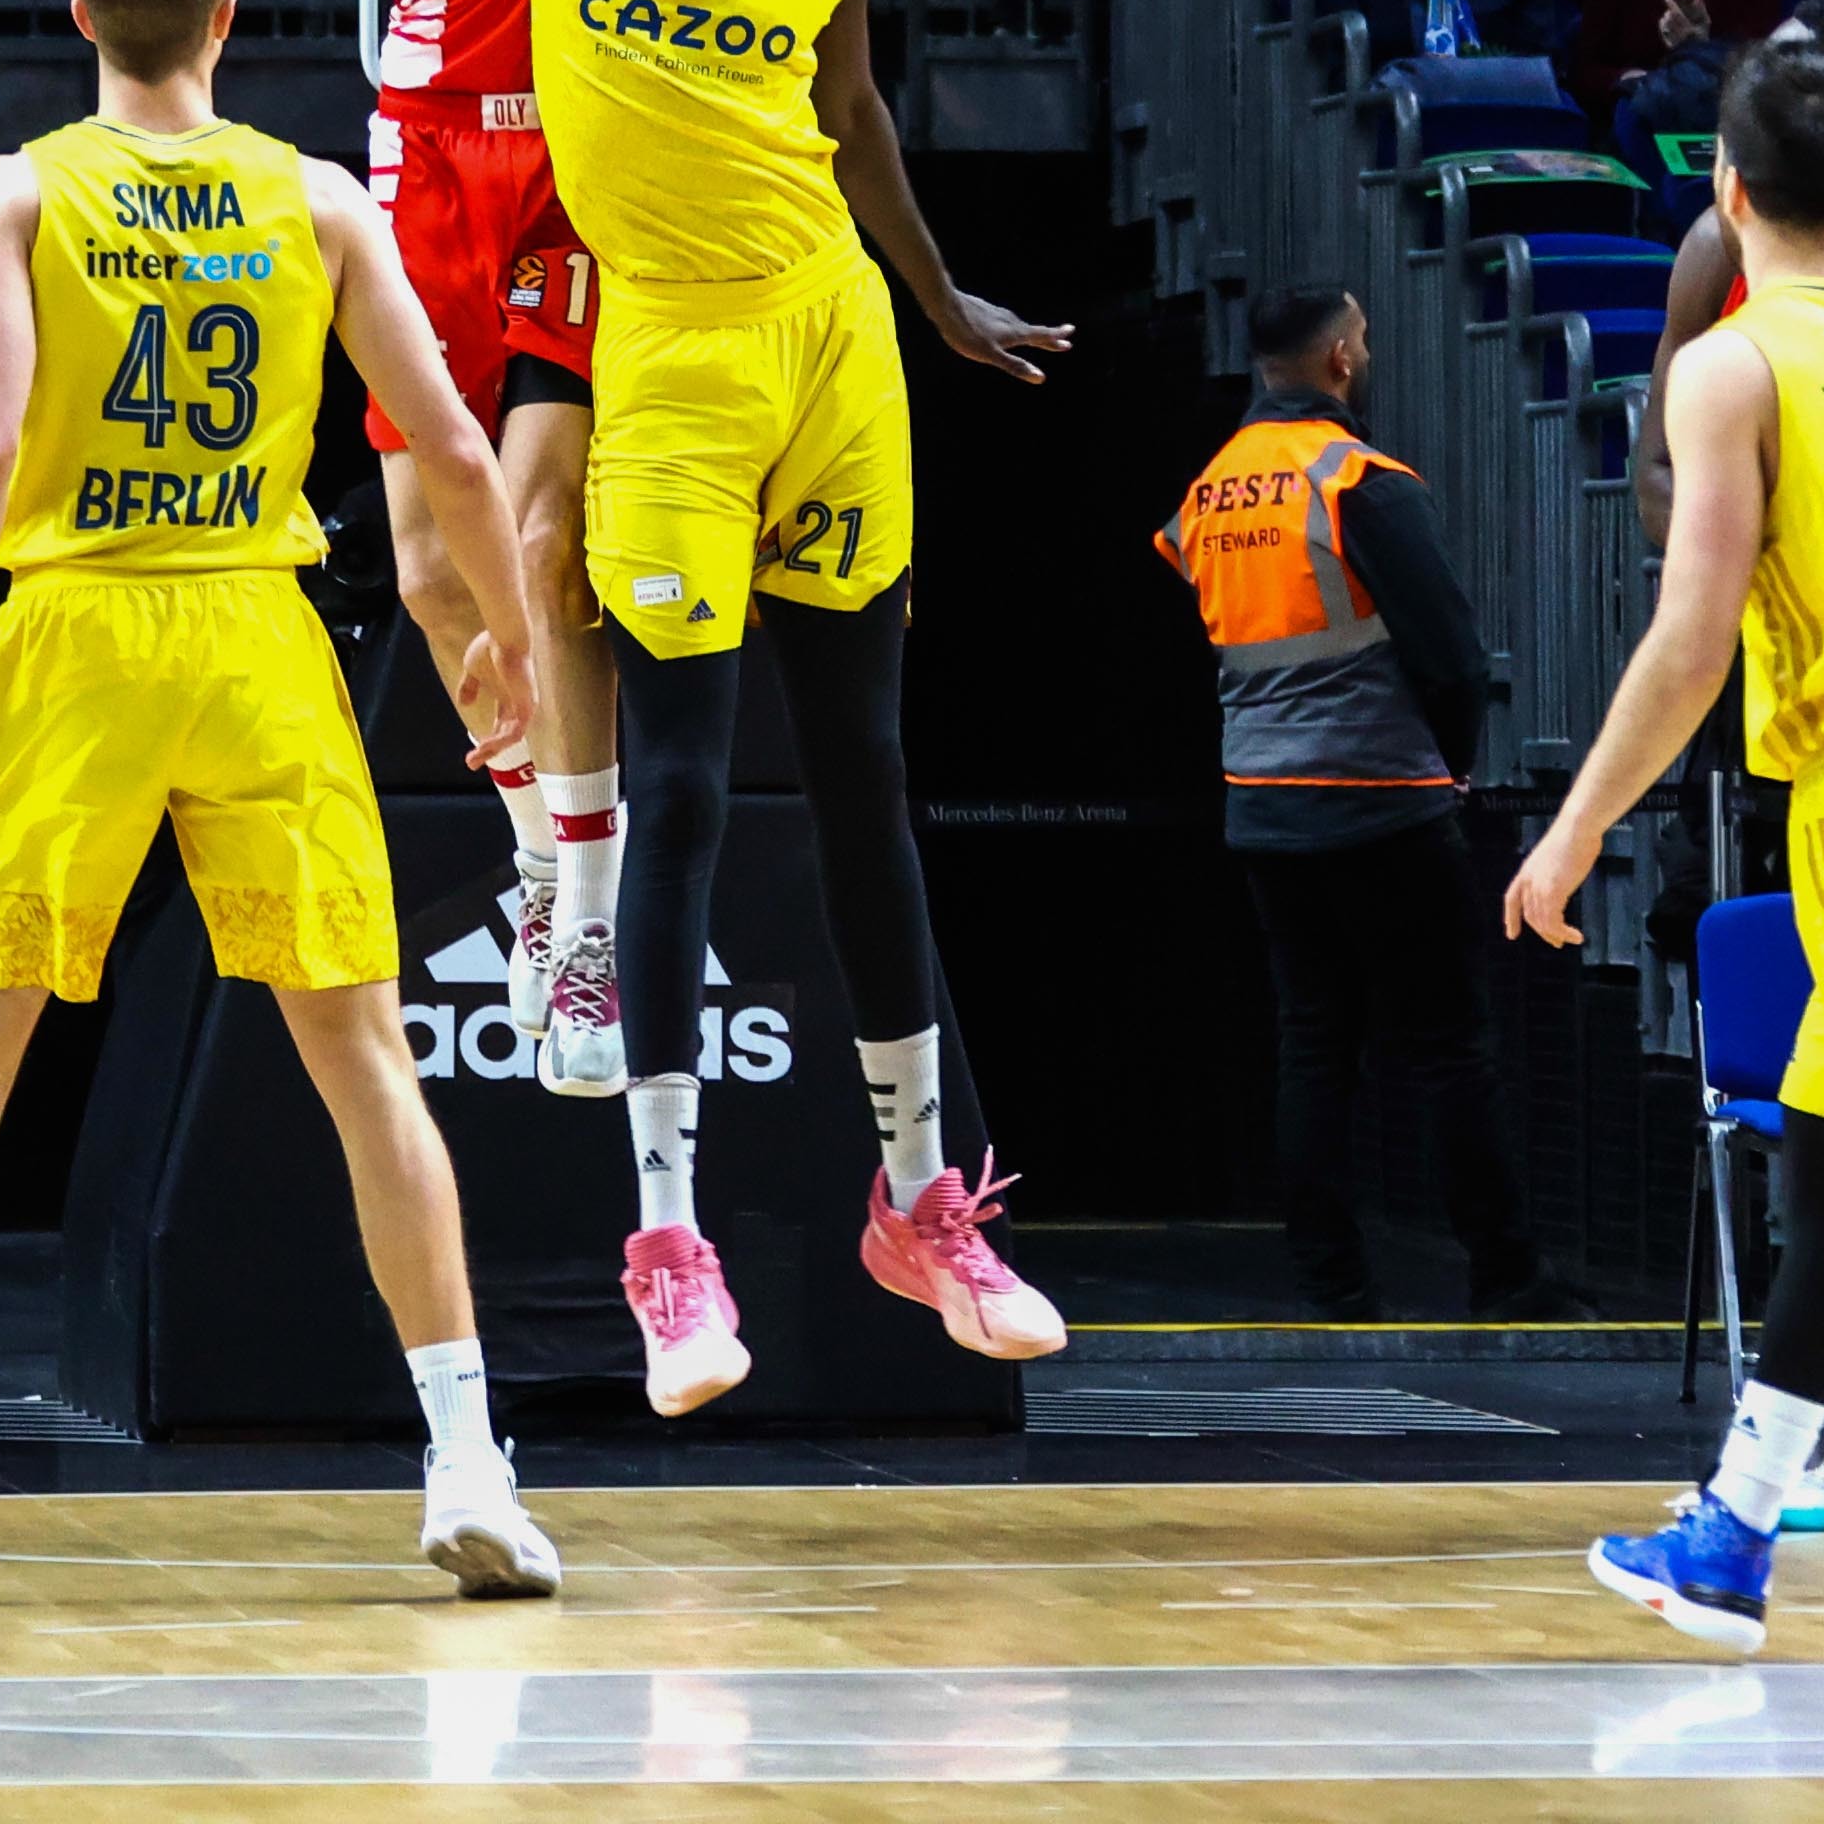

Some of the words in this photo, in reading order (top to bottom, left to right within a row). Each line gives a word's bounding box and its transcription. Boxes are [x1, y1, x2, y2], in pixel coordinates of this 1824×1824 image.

[112, 181, 246, 232] SIKMA
[102, 303, 260, 451] 43
[76, 464, 267, 530] BERLIN
[784, 500, 863, 579] 21
[1202, 527, 1281, 556] STEWARD
